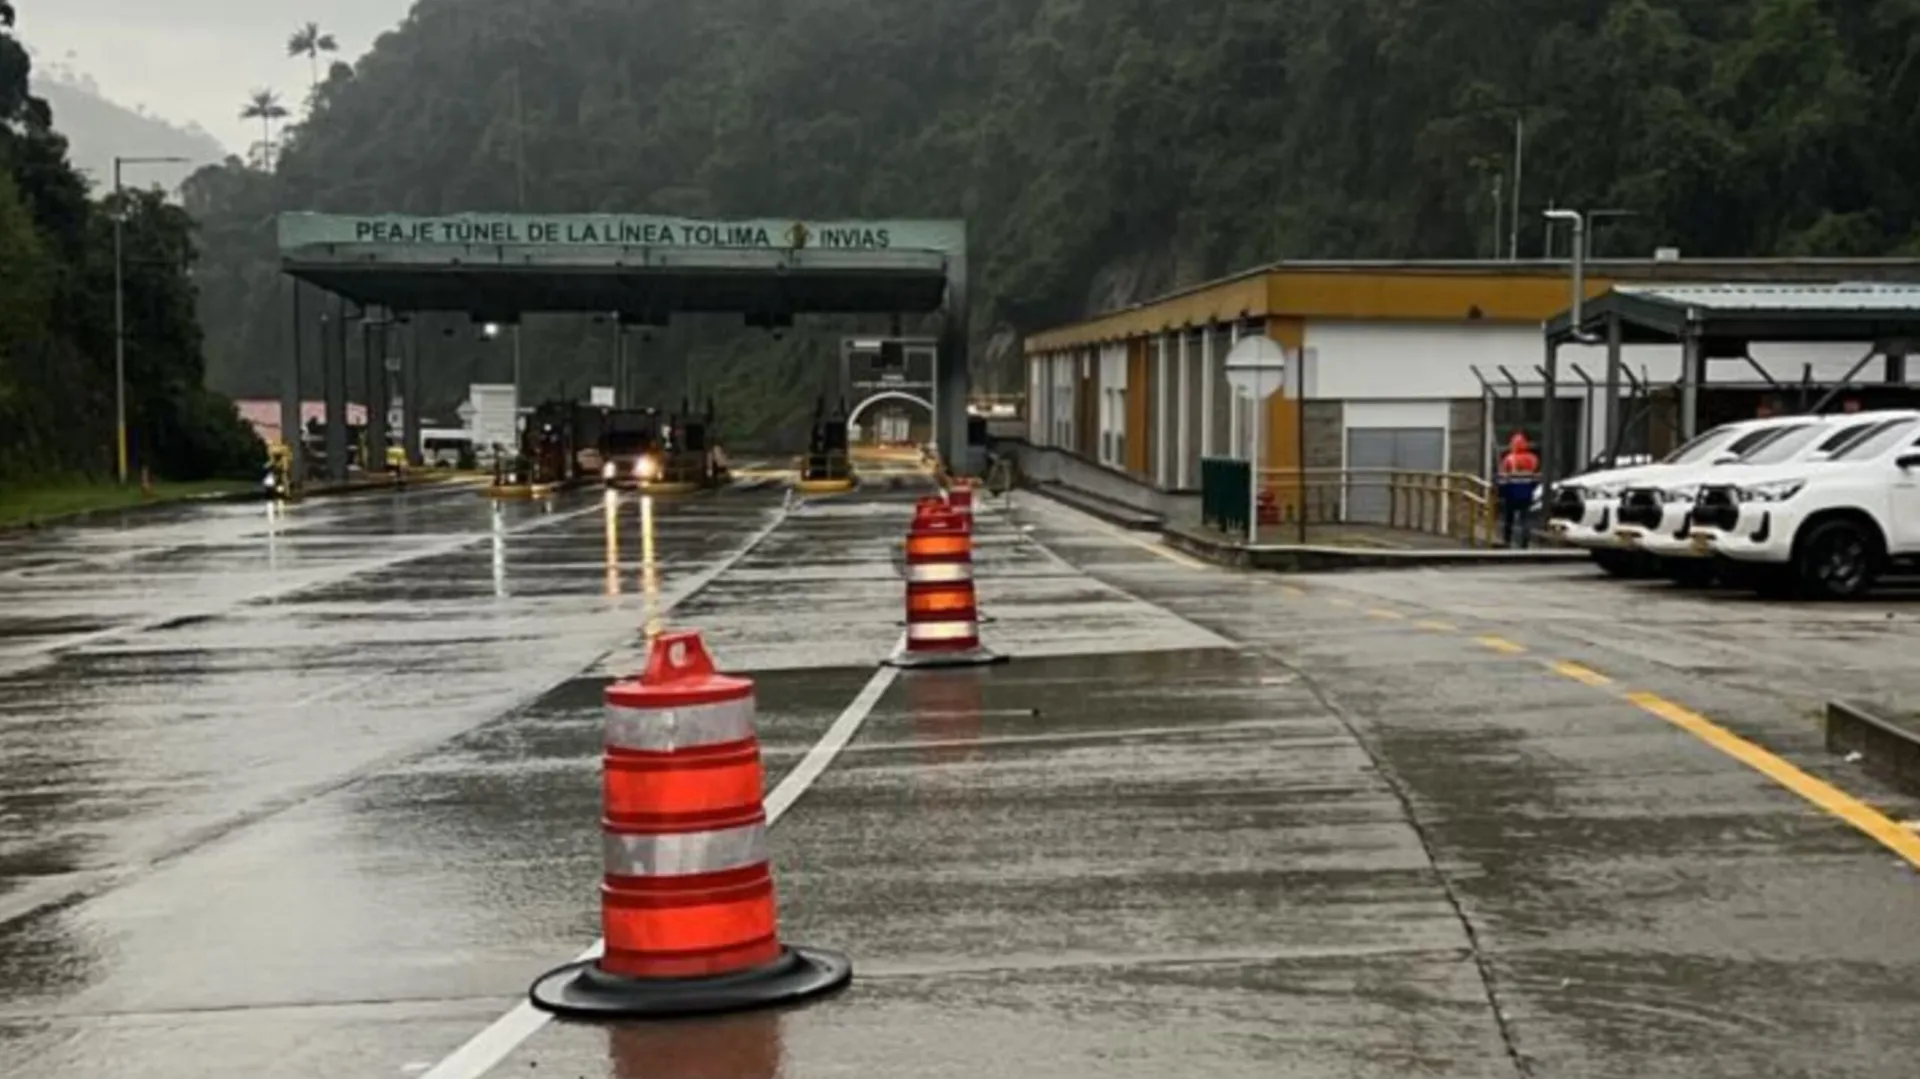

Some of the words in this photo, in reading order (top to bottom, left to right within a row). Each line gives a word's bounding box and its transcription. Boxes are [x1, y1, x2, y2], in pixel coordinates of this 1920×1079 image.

[356, 221, 433, 241] PEAJE
[442, 217, 520, 242] TÚNEL
[527, 221, 560, 242] DE
[567, 223, 599, 242] LA
[604, 218, 675, 243] LÍNEA
[680, 225, 771, 246] TOLIMA
[819, 228, 890, 248] INVIAS
